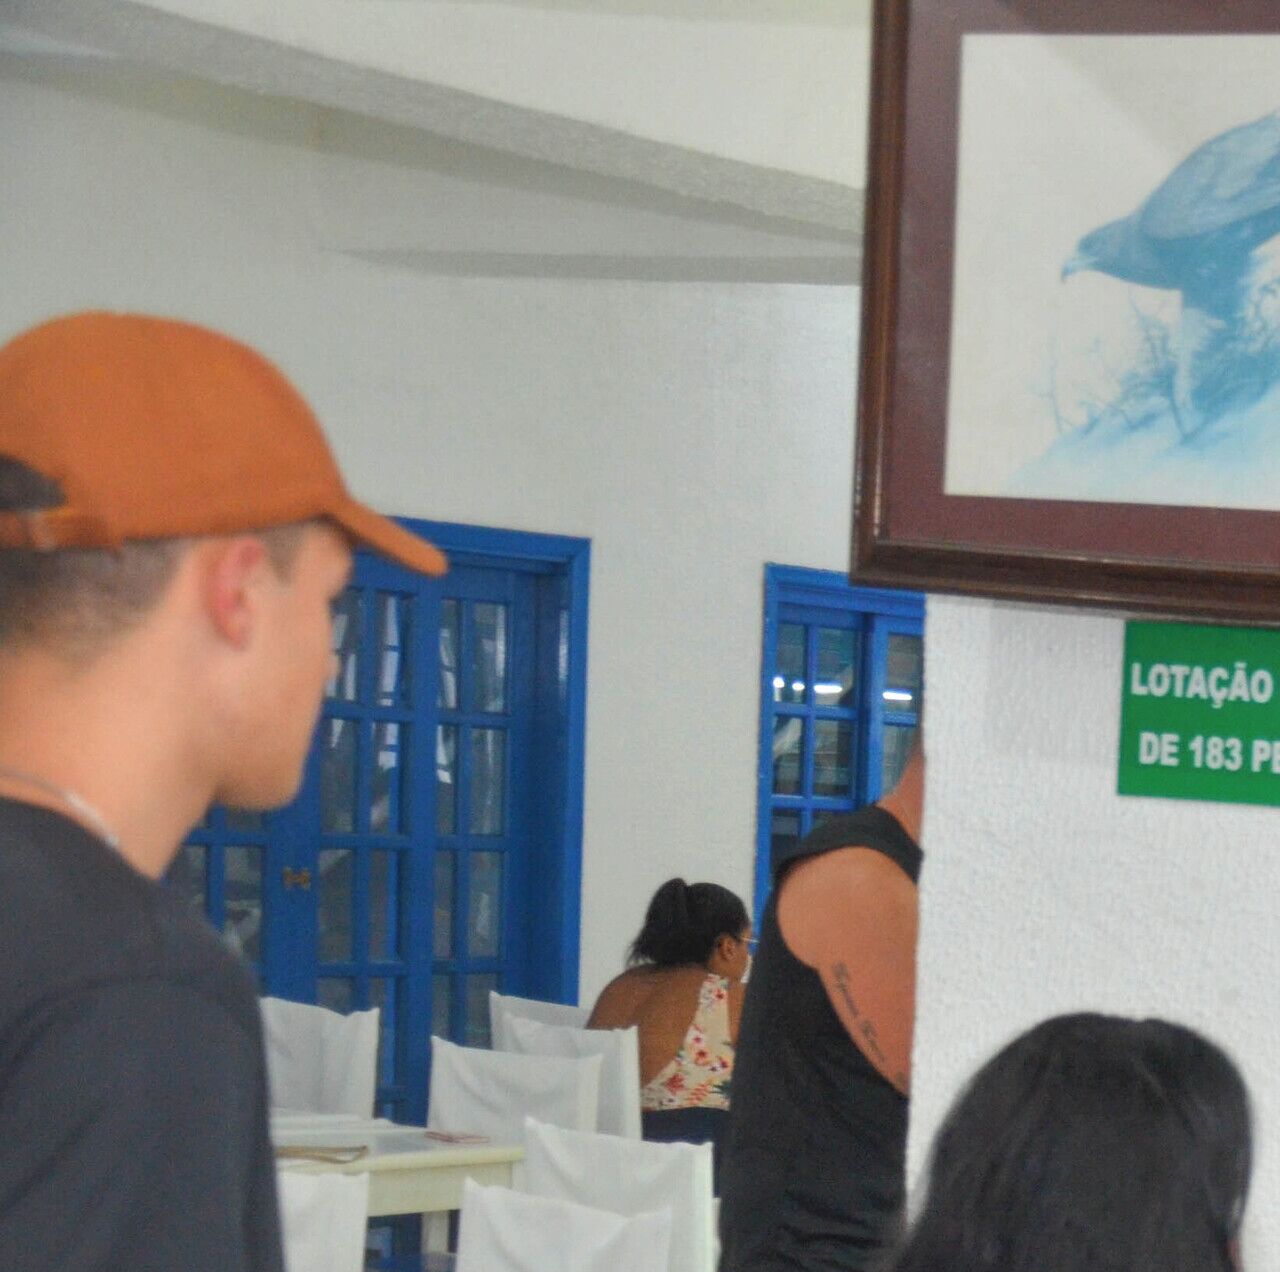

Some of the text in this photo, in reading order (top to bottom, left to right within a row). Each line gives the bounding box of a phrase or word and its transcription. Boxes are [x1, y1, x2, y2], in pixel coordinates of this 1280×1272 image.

[1131, 661, 1273, 709] LOTAÇÃO
[1139, 731, 1180, 767] DE
[1188, 735, 1243, 771] 183
